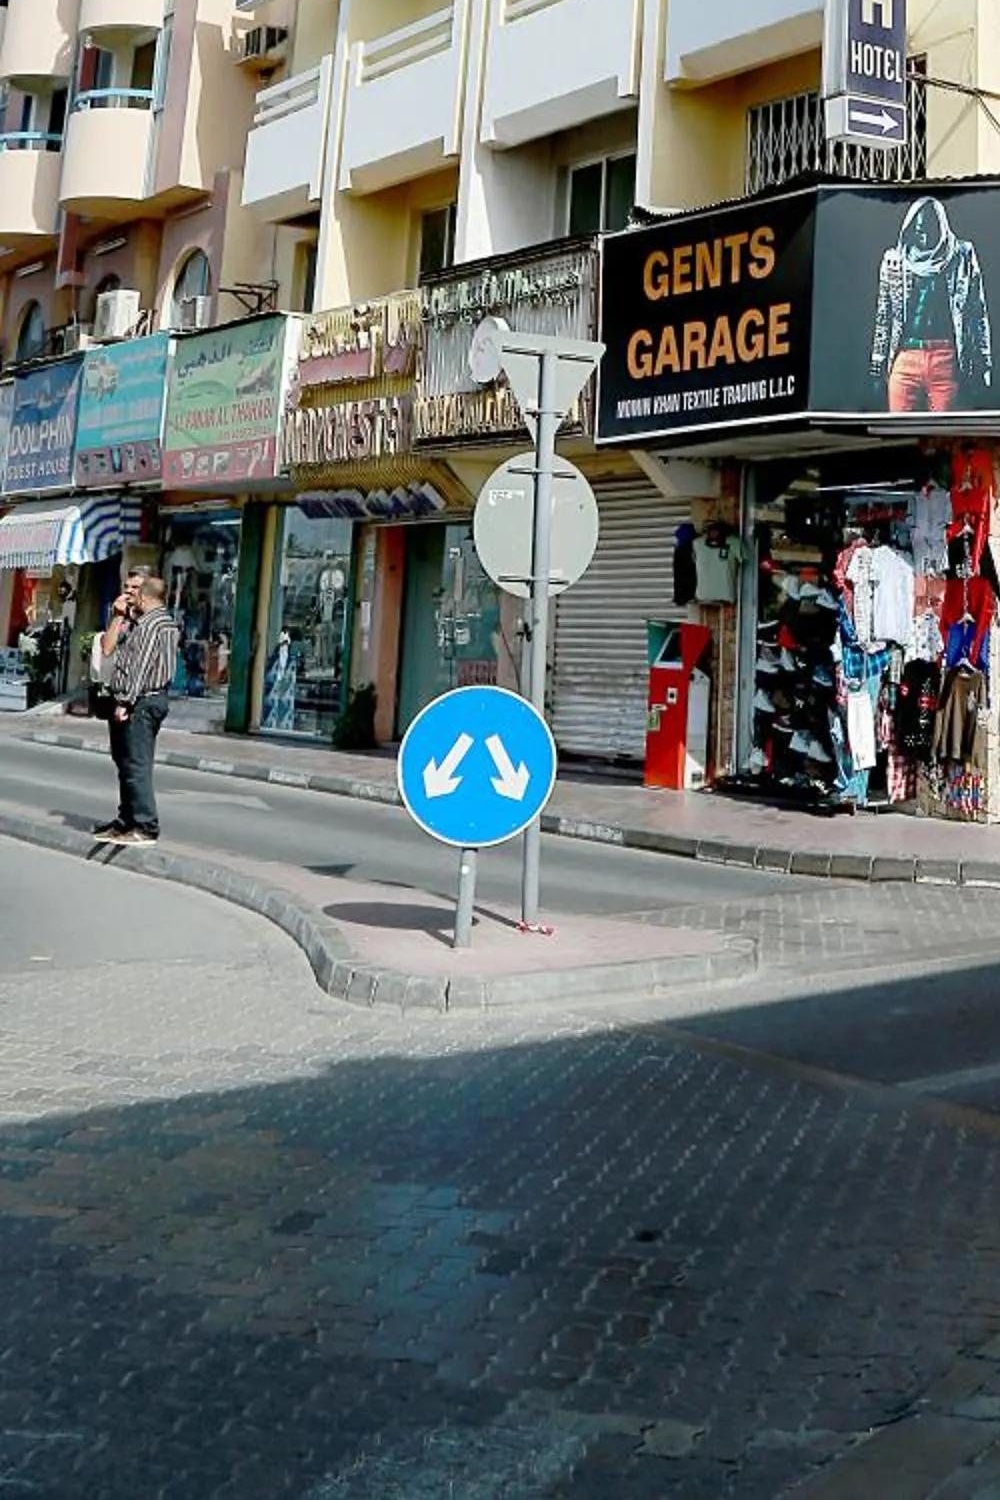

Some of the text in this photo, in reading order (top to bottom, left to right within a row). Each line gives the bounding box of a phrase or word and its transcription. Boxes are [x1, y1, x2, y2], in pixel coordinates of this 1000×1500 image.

[851, 40, 902, 83] HOTEL
[642, 225, 776, 301] GENTS
[626, 301, 792, 380] GARAGE
[653, 393, 681, 415] KHAN
[682, 386, 721, 411] TEXTILE
[722, 379, 767, 407] TRADING
[9, 414, 73, 456] DOLPHIN
